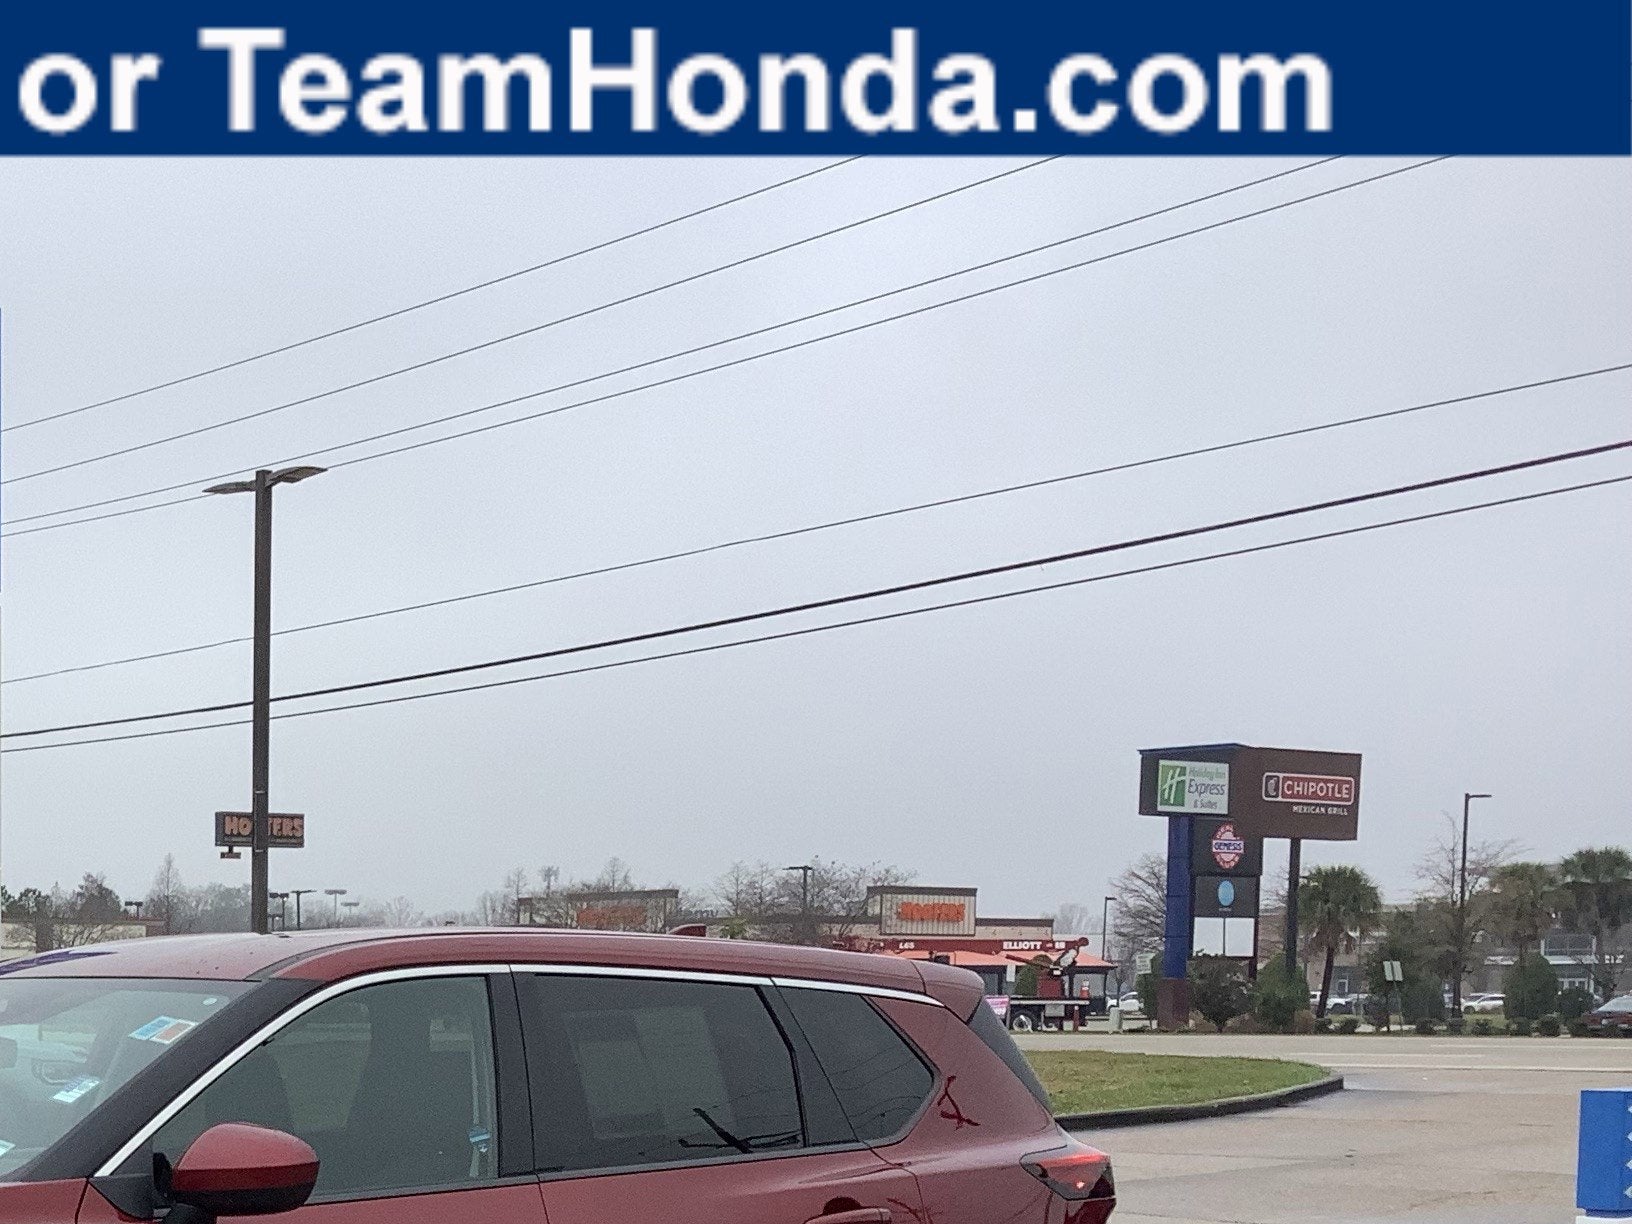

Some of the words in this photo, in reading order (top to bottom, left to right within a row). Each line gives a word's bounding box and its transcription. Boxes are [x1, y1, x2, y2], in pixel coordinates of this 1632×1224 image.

[1188, 779, 1226, 797] Express
[1284, 780, 1350, 798] CHIPOTLE
[1292, 805, 1325, 814] MEXICAN
[1327, 807, 1348, 816] GRILL
[224, 815, 303, 837] HOERS
[1002, 941, 1042, 950] ELLIOTT
